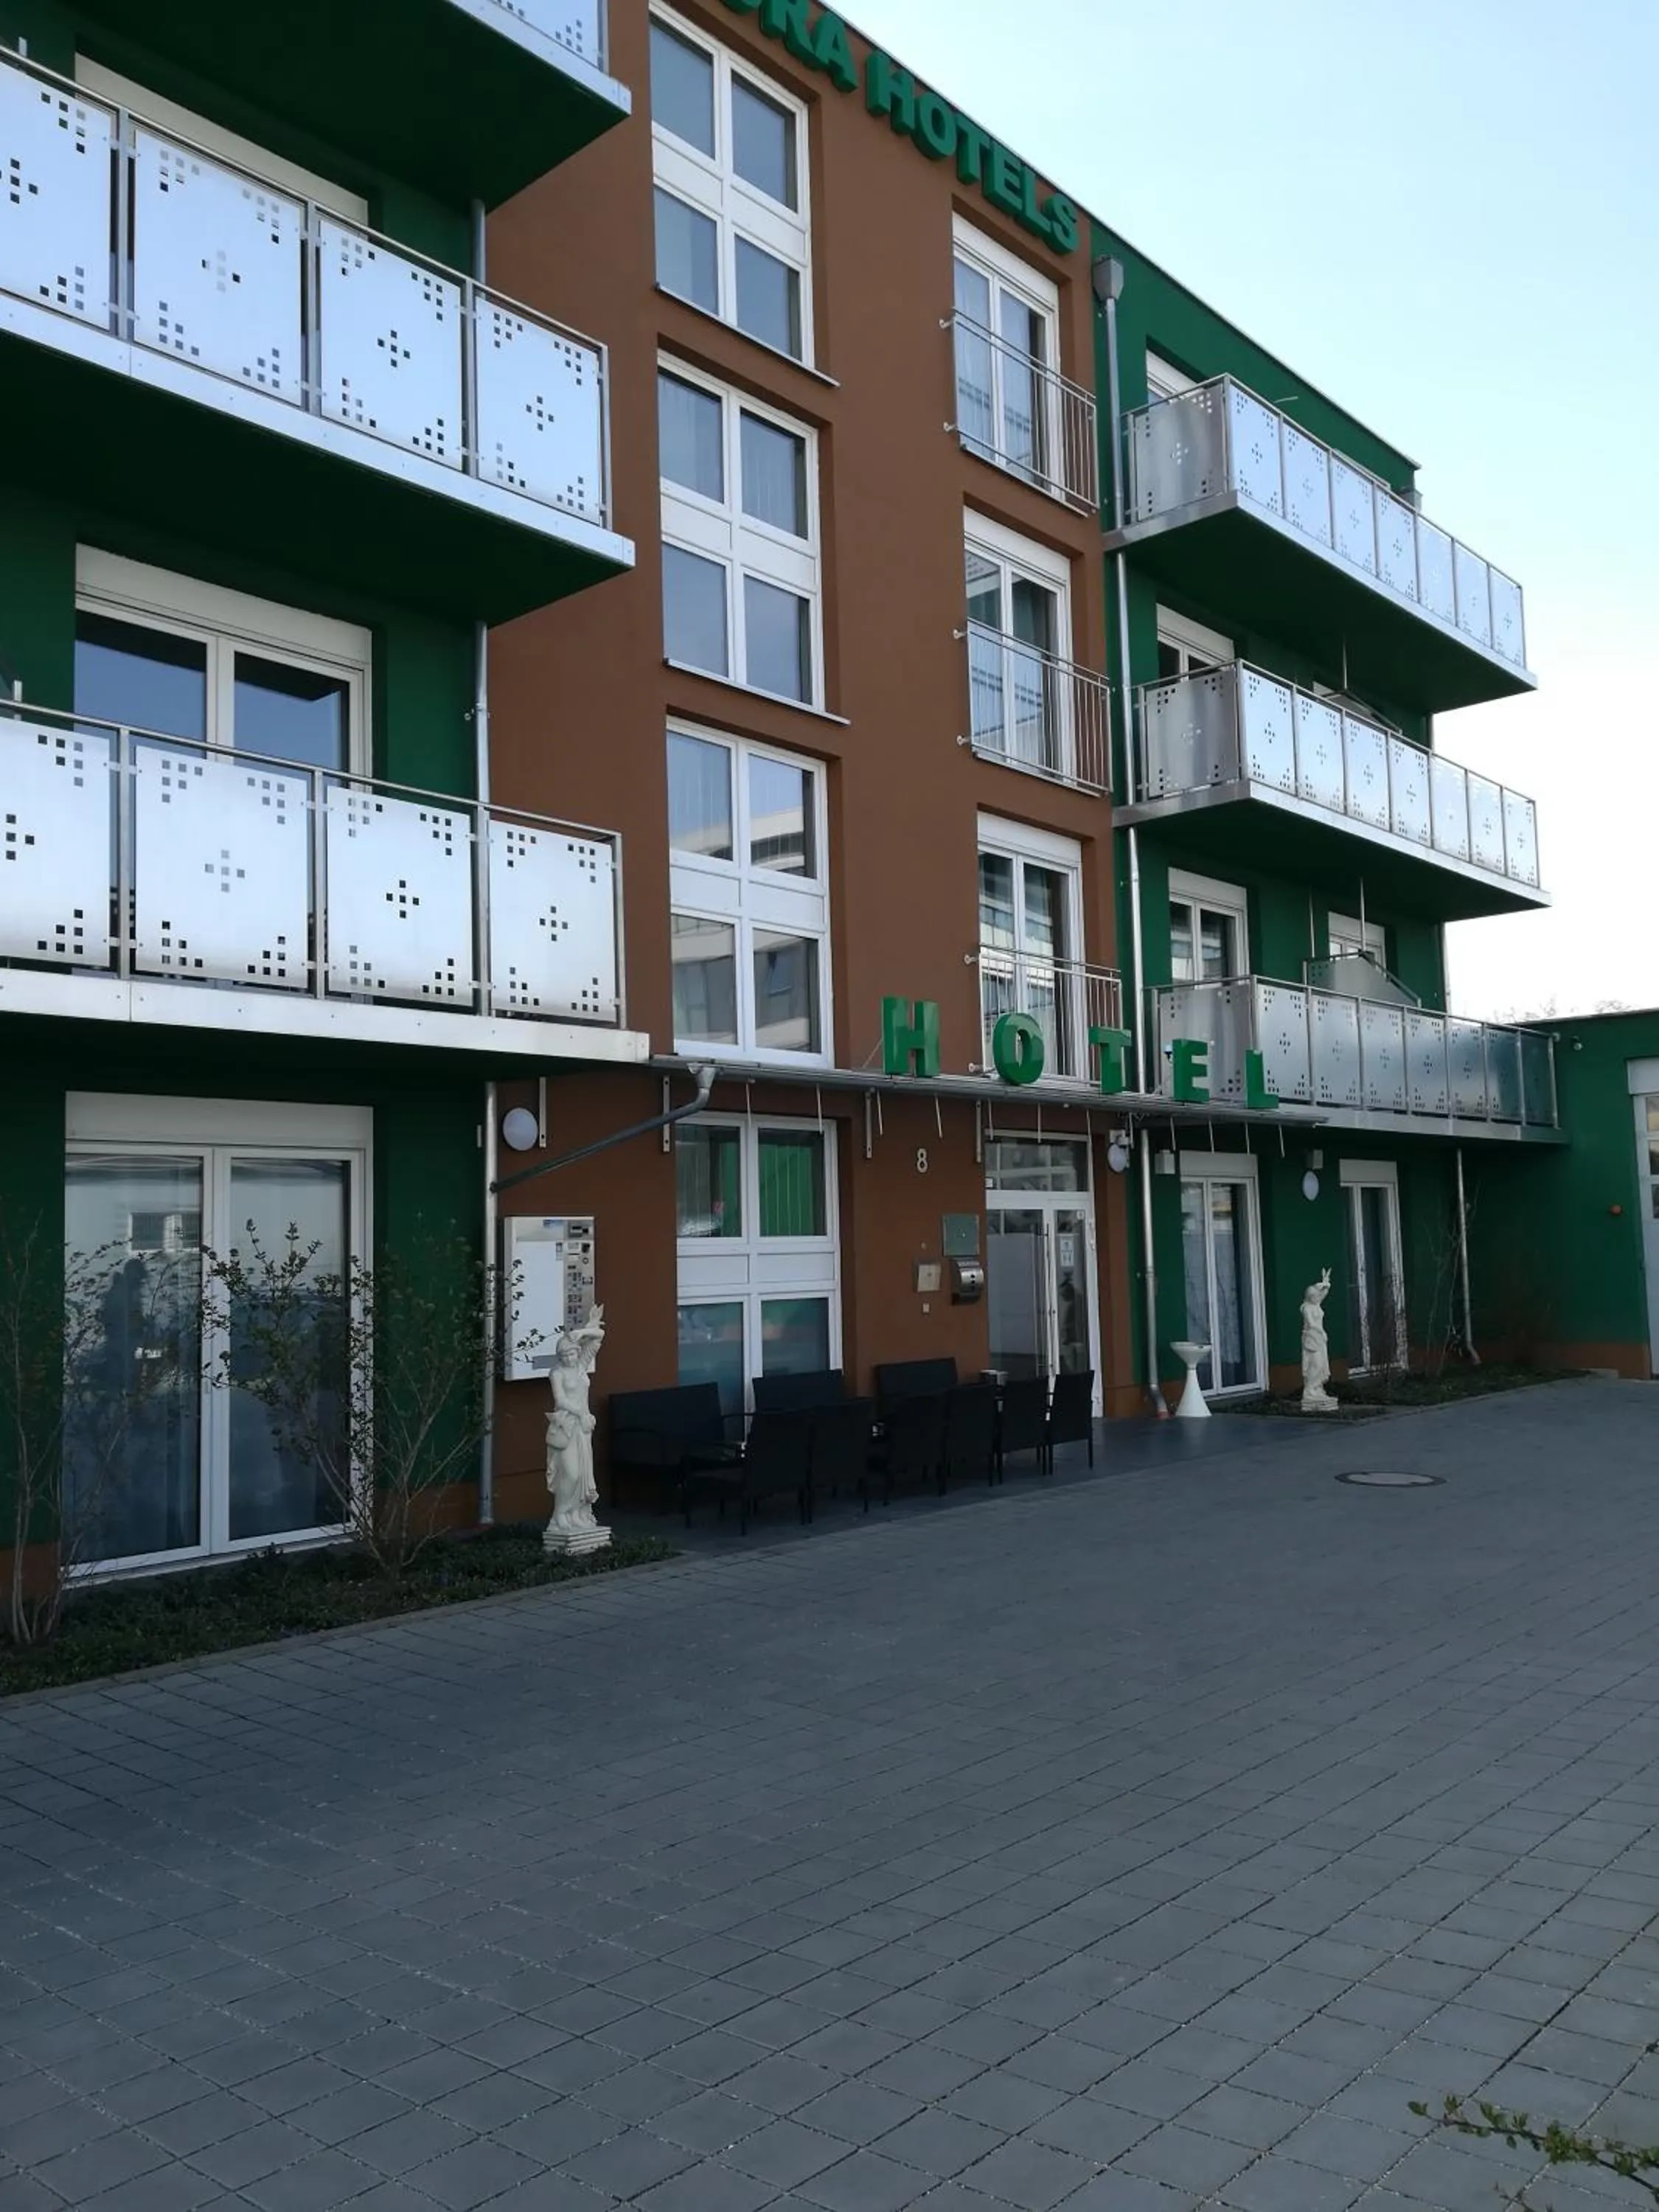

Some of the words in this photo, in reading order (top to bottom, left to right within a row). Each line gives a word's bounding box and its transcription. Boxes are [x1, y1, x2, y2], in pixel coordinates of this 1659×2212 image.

[719, 0, 858, 94] RA
[866, 49, 1079, 254] HOTELS
[882, 996, 1279, 1109] HOTEL
[916, 1148, 928, 1173] 8
